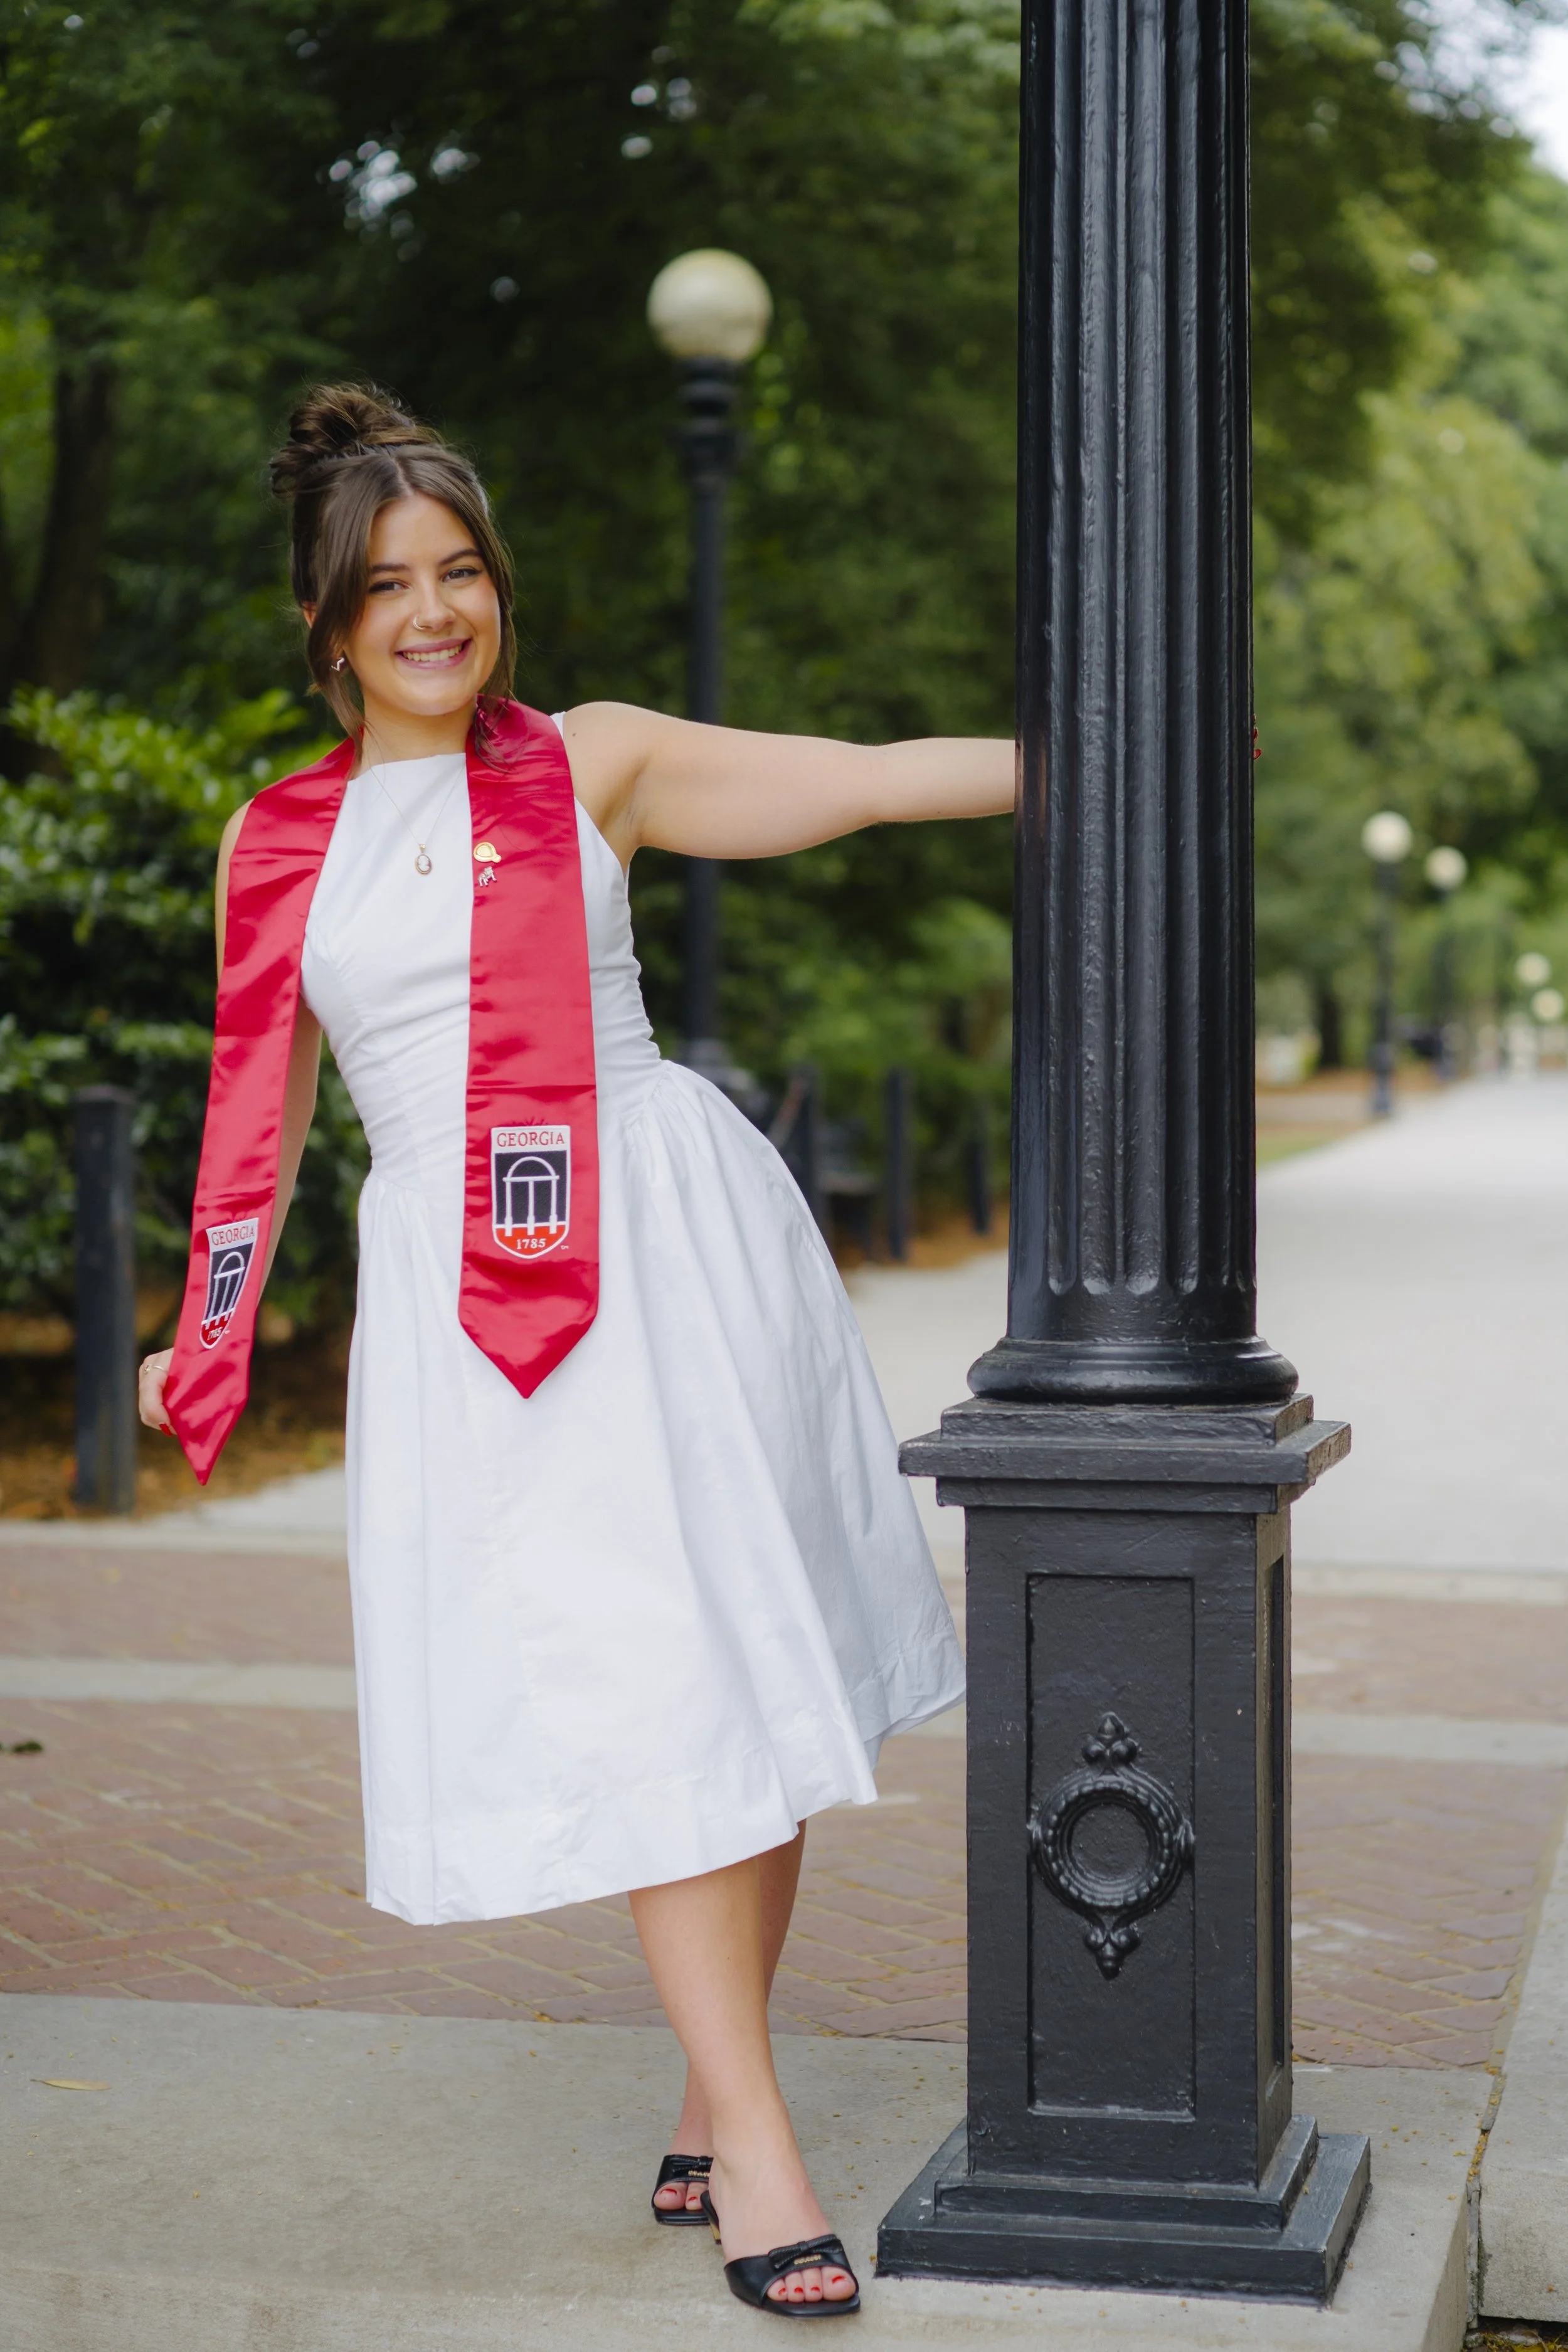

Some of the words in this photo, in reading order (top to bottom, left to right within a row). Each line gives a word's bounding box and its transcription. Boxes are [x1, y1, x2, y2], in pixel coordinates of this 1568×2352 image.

[497, 1131, 565, 1147] GEORGIA
[211, 1225, 255, 1246] GEORGIA
[516, 1238, 546, 1250] 1785
